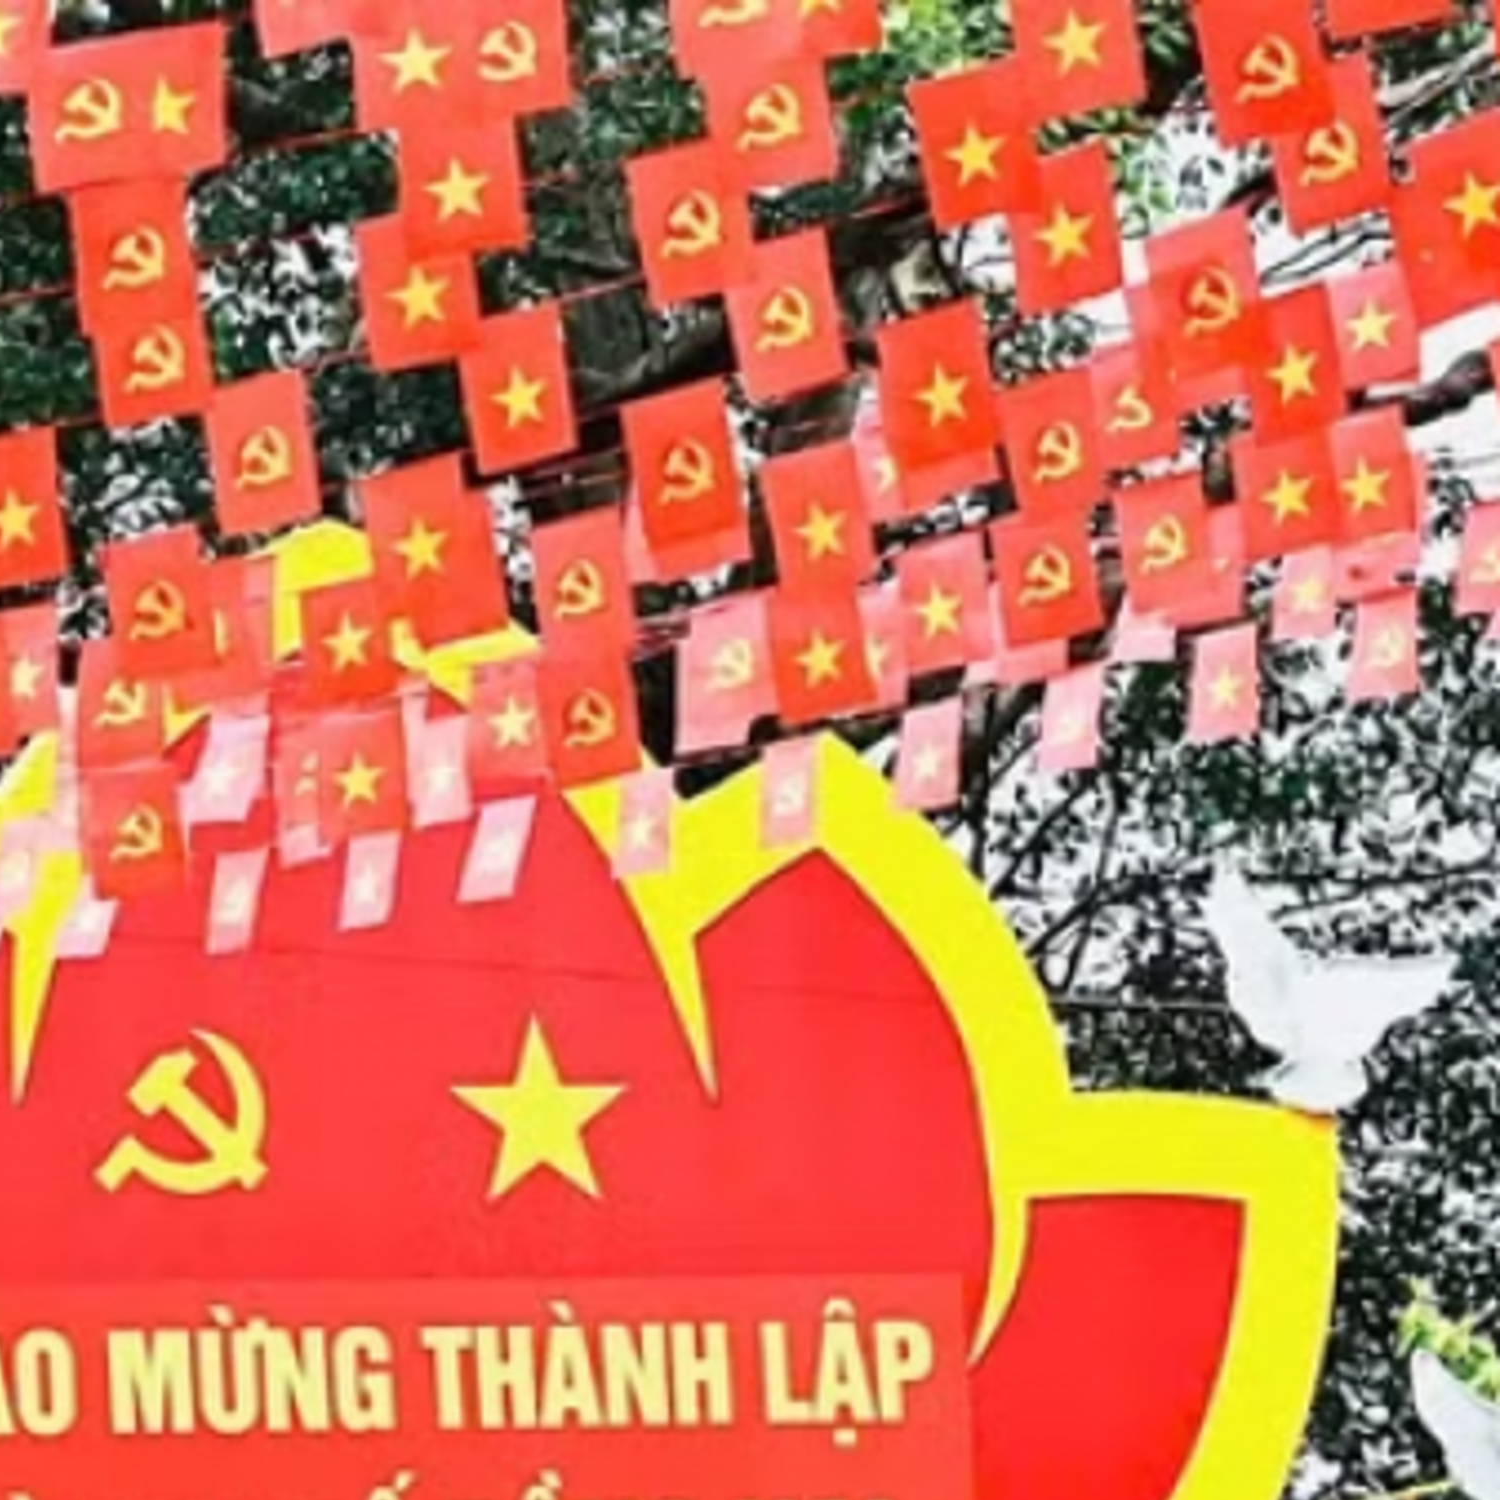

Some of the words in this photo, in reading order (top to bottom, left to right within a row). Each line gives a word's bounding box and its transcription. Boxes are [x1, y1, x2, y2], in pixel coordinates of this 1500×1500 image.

[107, 1303, 395, 1434] MỪNG
[420, 1298, 732, 1429] THÀNH
[760, 1297, 934, 1447] LẬP
